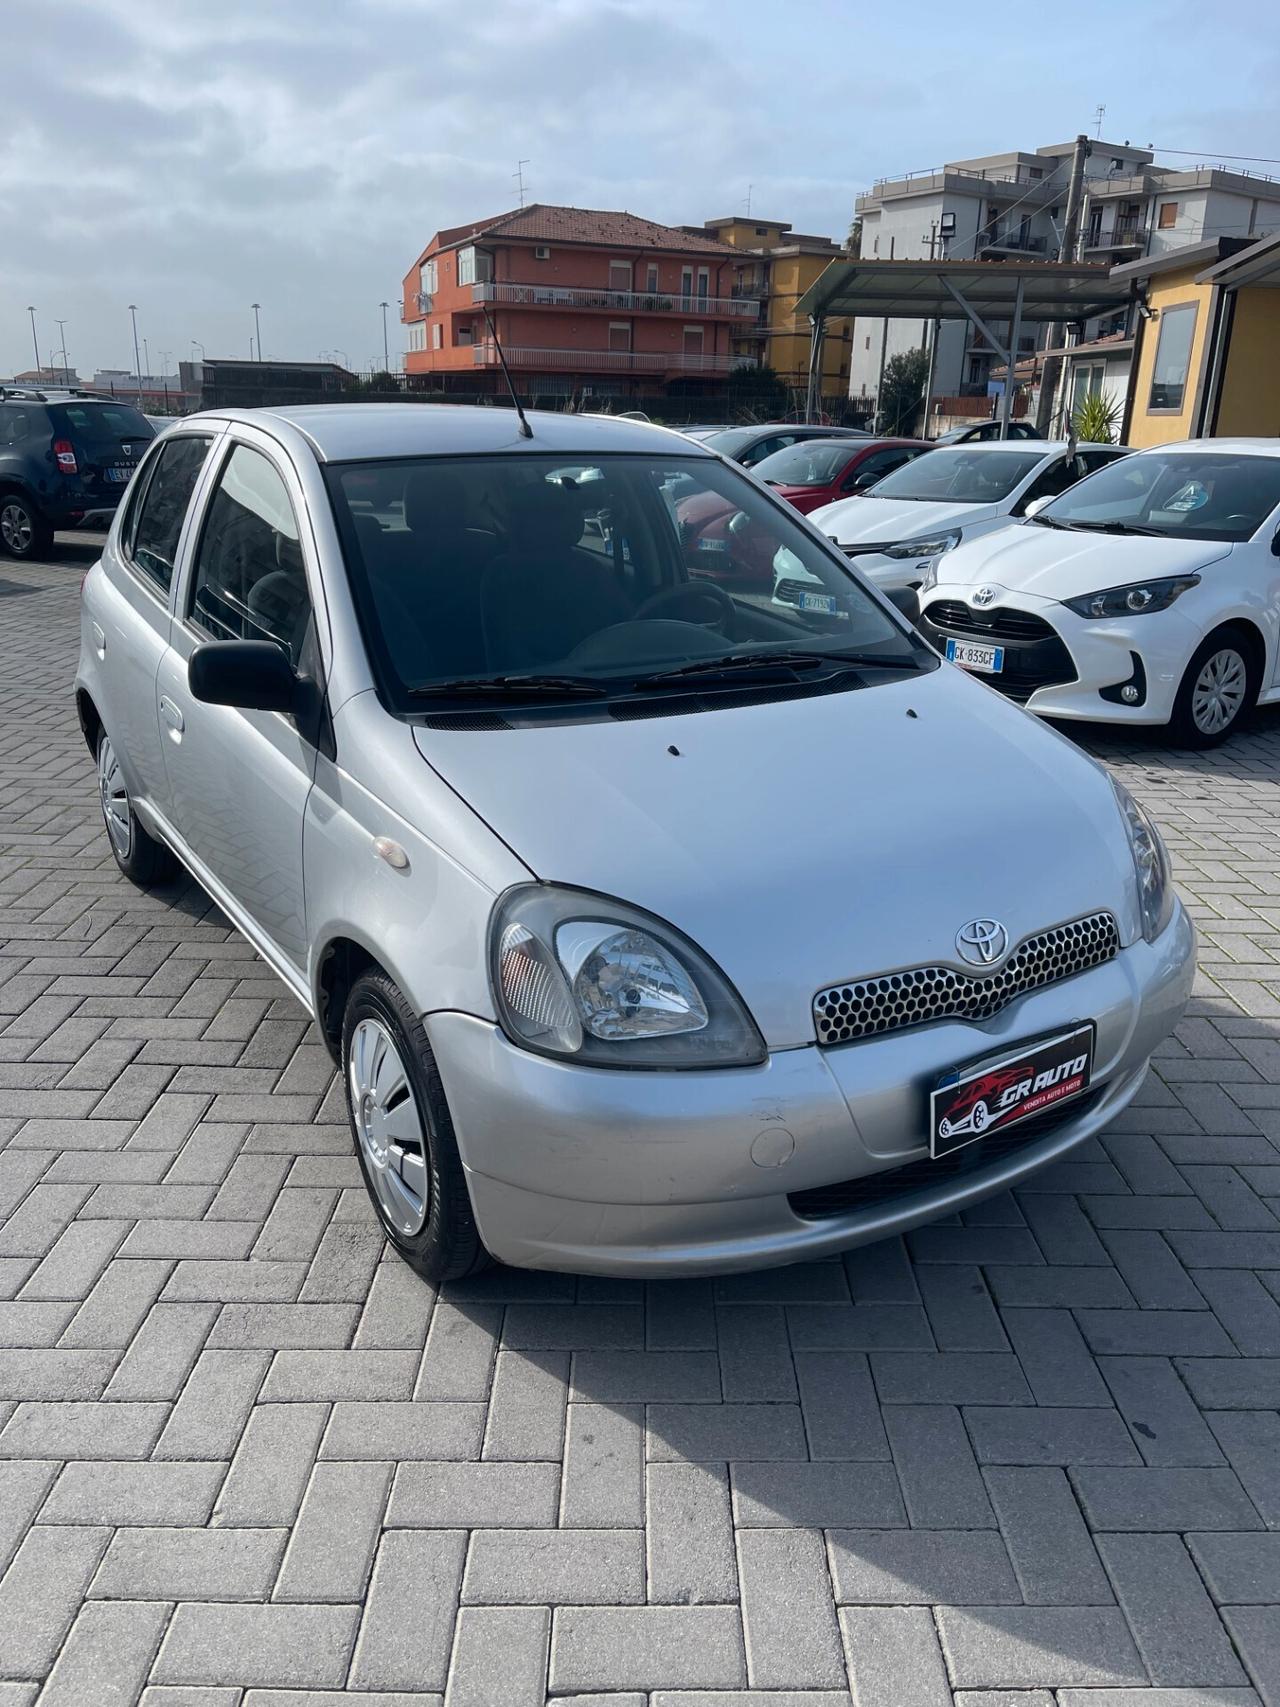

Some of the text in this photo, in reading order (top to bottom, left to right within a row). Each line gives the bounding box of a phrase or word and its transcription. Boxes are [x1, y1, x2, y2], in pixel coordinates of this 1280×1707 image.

[998, 1053, 1088, 1107] GR AUTO
[1023, 1097, 1046, 1111] VENDITA
[1046, 1088, 1061, 1100] AUTO
[1066, 1079, 1081, 1092] MOTO
